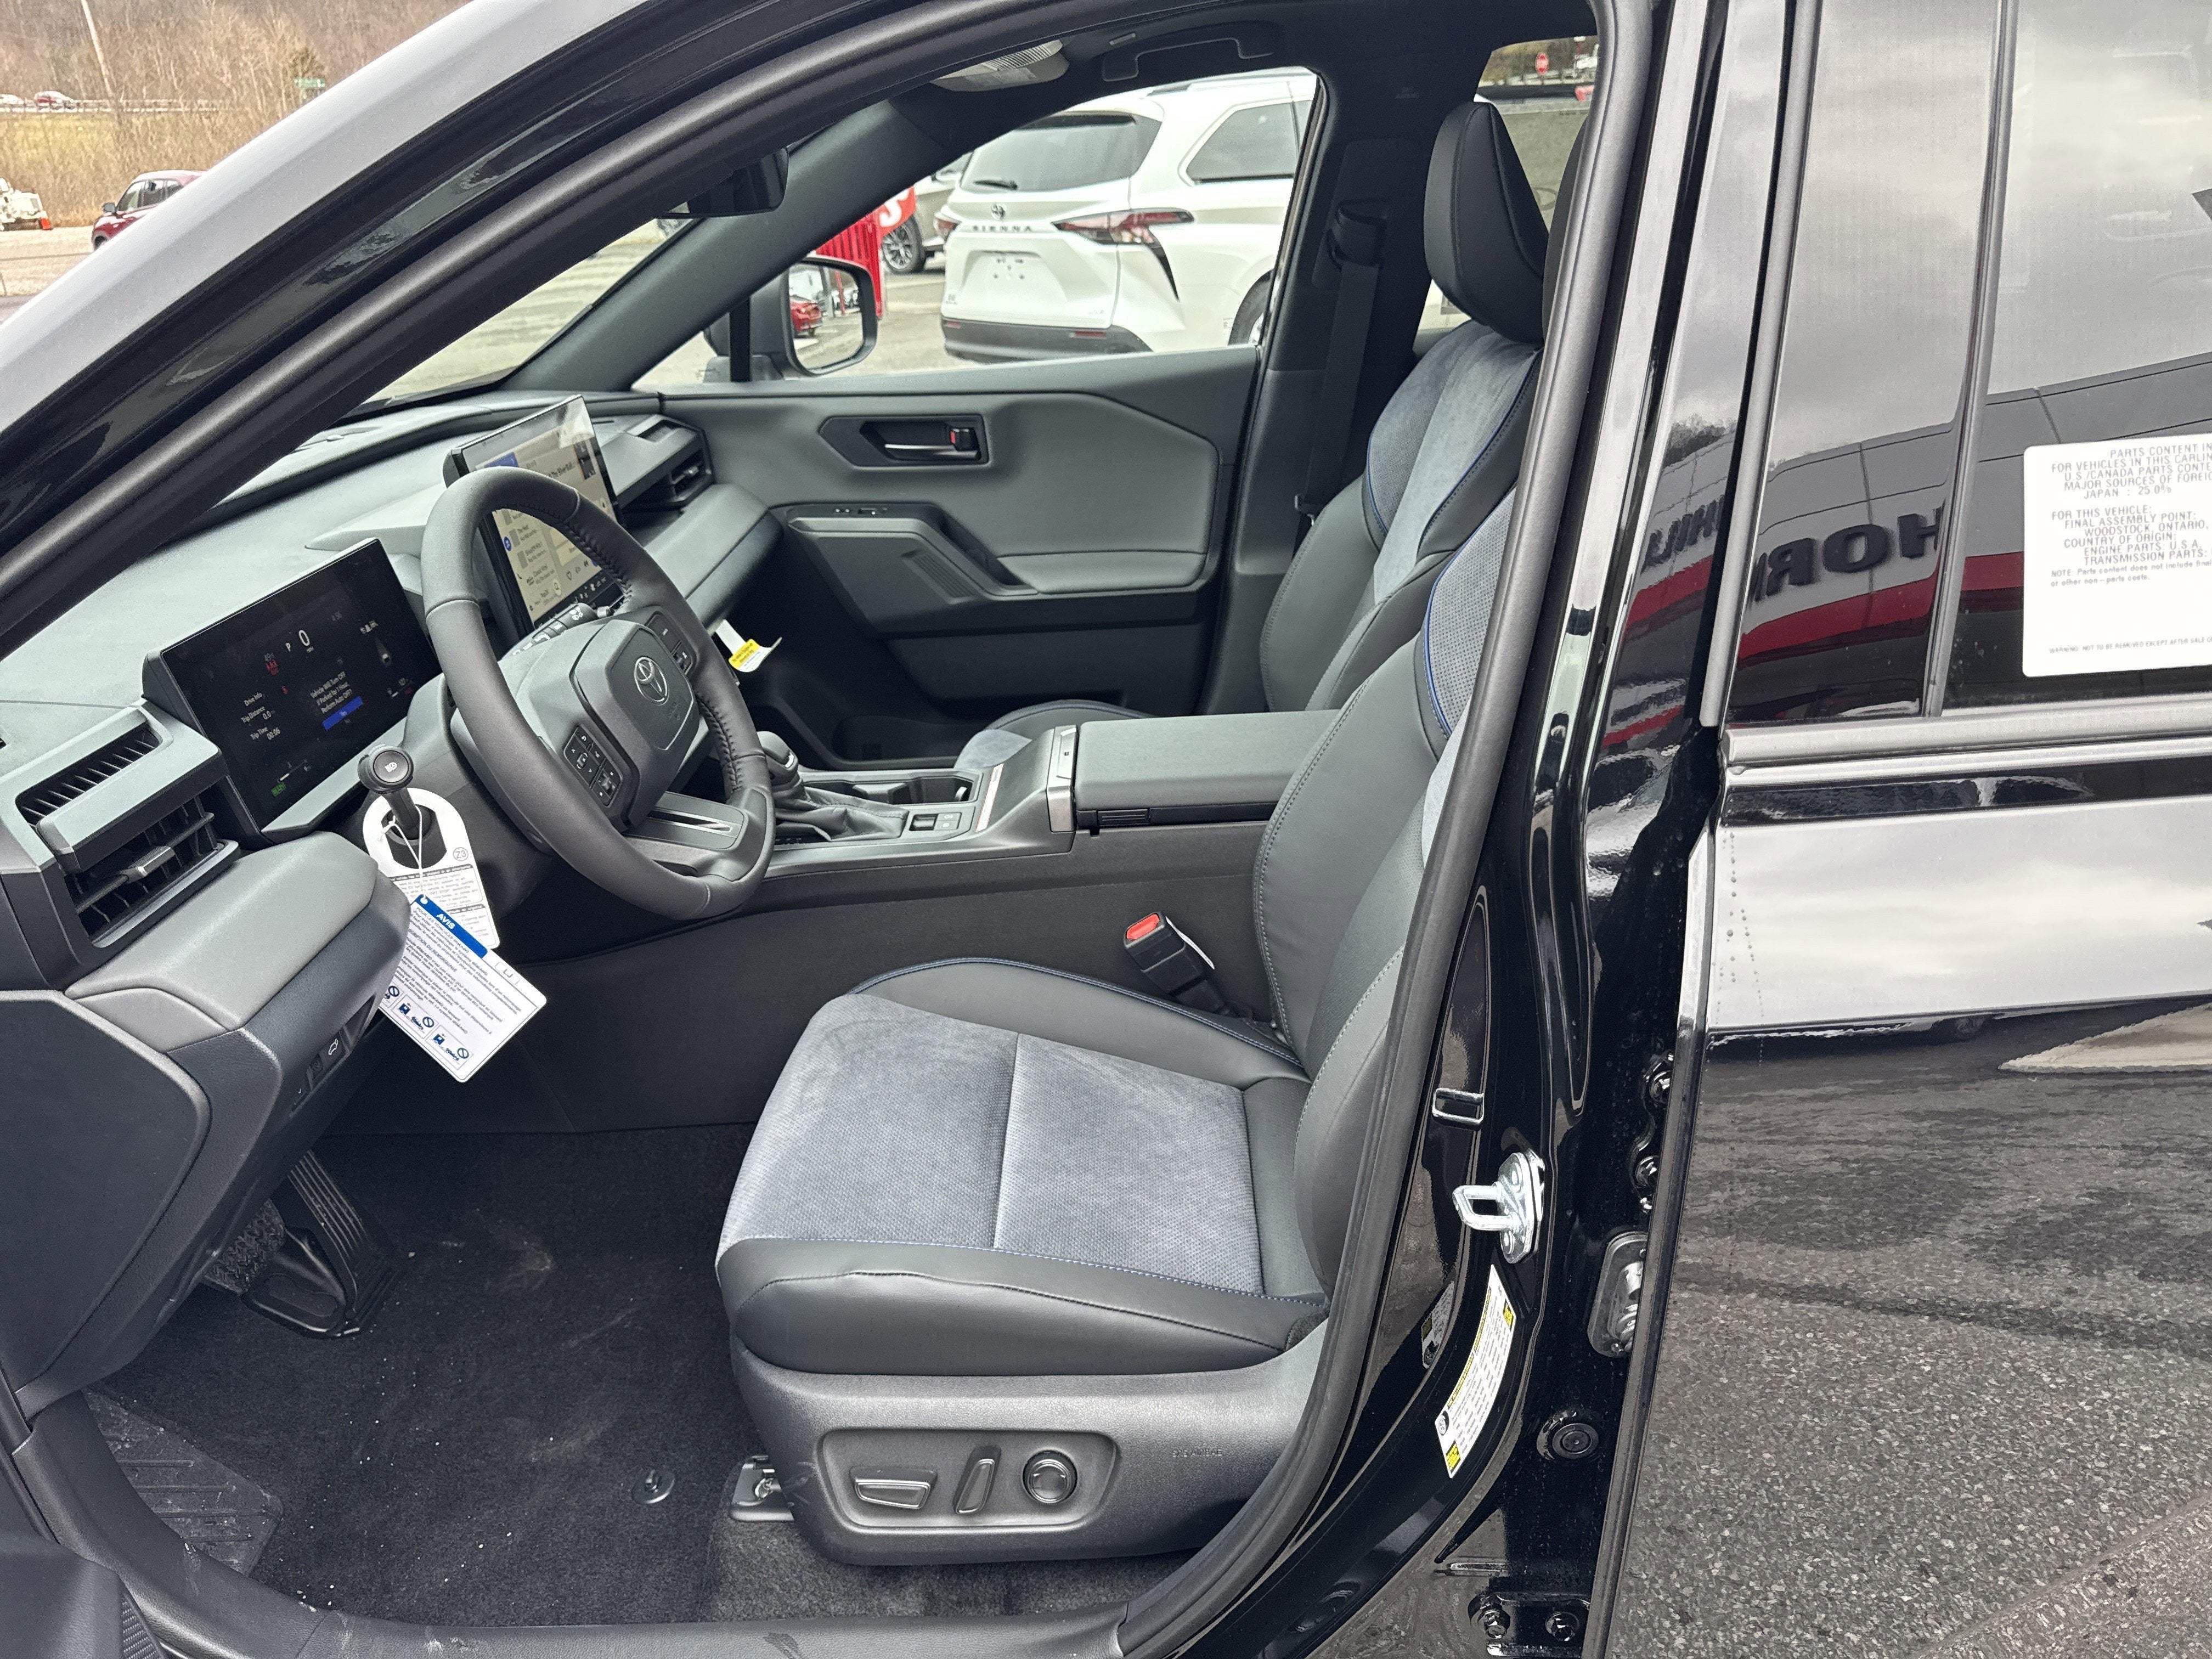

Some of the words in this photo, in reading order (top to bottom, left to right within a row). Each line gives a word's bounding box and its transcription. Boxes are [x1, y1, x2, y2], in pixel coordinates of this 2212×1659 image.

[972, 224, 1032, 233] SIENNA
[2111, 447, 2145, 458] PARTS
[2149, 444, 2197, 455] CONTENT
[2052, 463, 2072, 472] FOR
[2076, 459, 2126, 471] VEHICLES
[2131, 458, 2141, 466] IN
[2146, 456, 2170, 465] THIS
[2065, 468, 2133, 481] U.S./CANADA
[2138, 465, 2172, 475] PARTS
[2064, 480, 2101, 490] MAJOR
[2106, 476, 2154, 488] SOURCES
[2160, 475, 2172, 484] OF
[2084, 488, 2118, 499] JAPAN
[2138, 484, 2171, 495] 25.0%
[2052, 511, 2072, 520] FOR
[2076, 508, 2100, 518] THIS
[2105, 505, 2151, 516] VEHICLE:
[2065, 518, 2095, 529] FINAL
[2099, 514, 2156, 526] ASSEMBLY
[2162, 511, 2196, 522] POINT:
[2085, 524, 2154, 537] WOODSTOCK,
[2159, 520, 2208, 532] ONTARIO,
[2064, 536, 2114, 548] COUNTRY
[2119, 535, 2131, 544] OF
[2136, 532, 2176, 543] ORIGIN:
[2084, 545, 2122, 556] ENGINE
[2128, 542, 2164, 552] PARTS:
[2170, 539, 2201, 550] U.S.A.
[2084, 551, 2164, 566] TRANSMISSION
[2169, 549, 2207, 559] PARTS:
[298, 630, 310, 646] 0
[285, 642, 291, 651] P
[310, 686, 324, 698] Vehicle
[244, 696, 255, 706] Drive
[241, 715, 250, 724] Trip
[248, 707, 266, 719] Distance
[250, 732, 259, 740] Trip
[257, 727, 268, 736] Time
[267, 727, 281, 740] 00:06
[455, 850, 467, 859] Z3
[436, 913, 456, 930] AVIS
